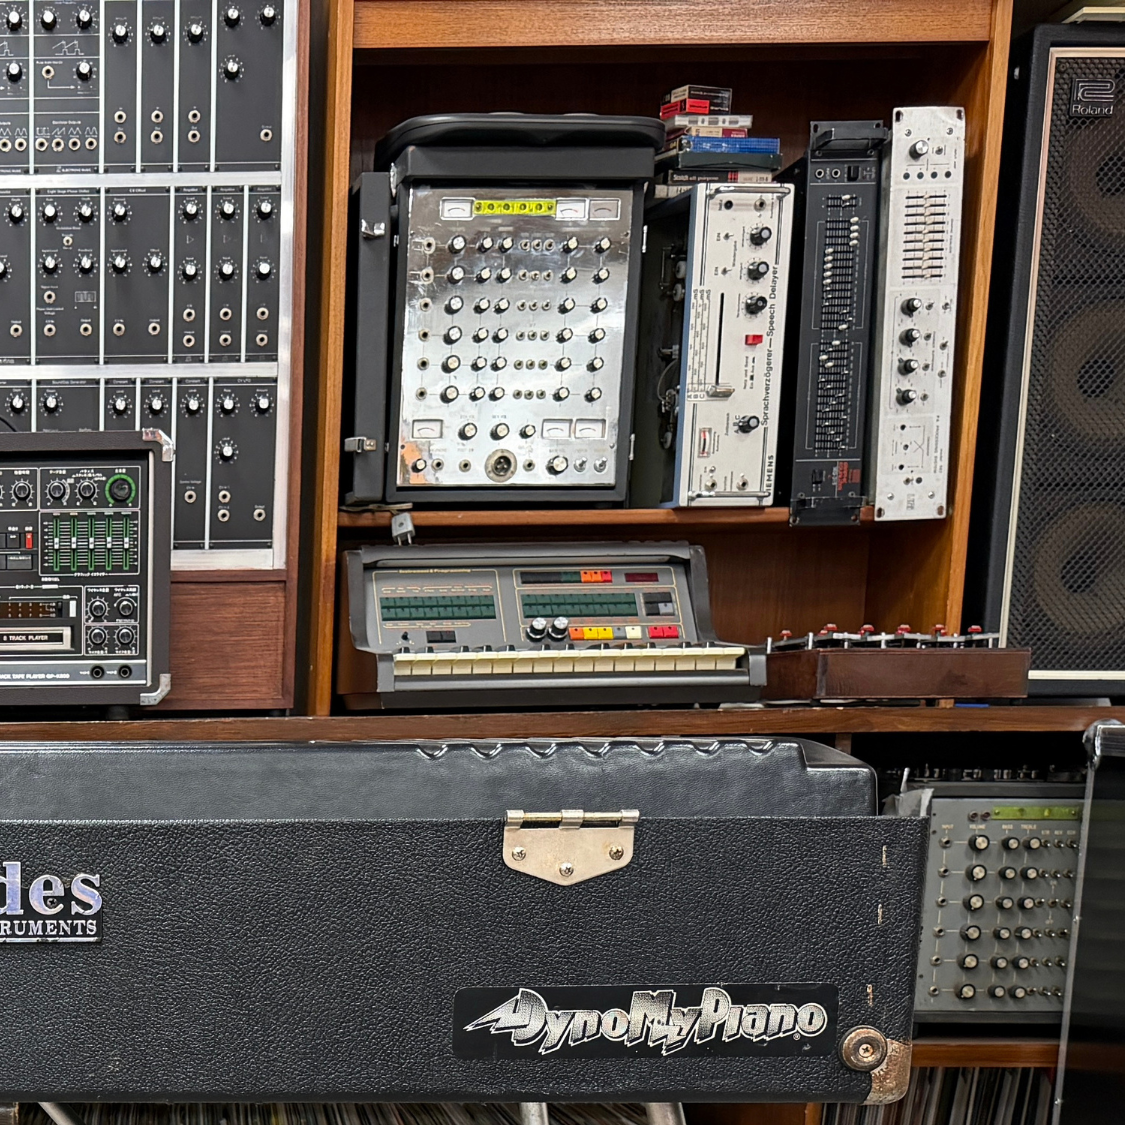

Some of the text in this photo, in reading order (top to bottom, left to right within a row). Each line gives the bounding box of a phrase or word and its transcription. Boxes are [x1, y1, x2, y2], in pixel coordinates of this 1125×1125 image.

[1072, 105, 1114, 115] Roland
[761, 266, 778, 426] Sprachverzögerer Speech Delayer
